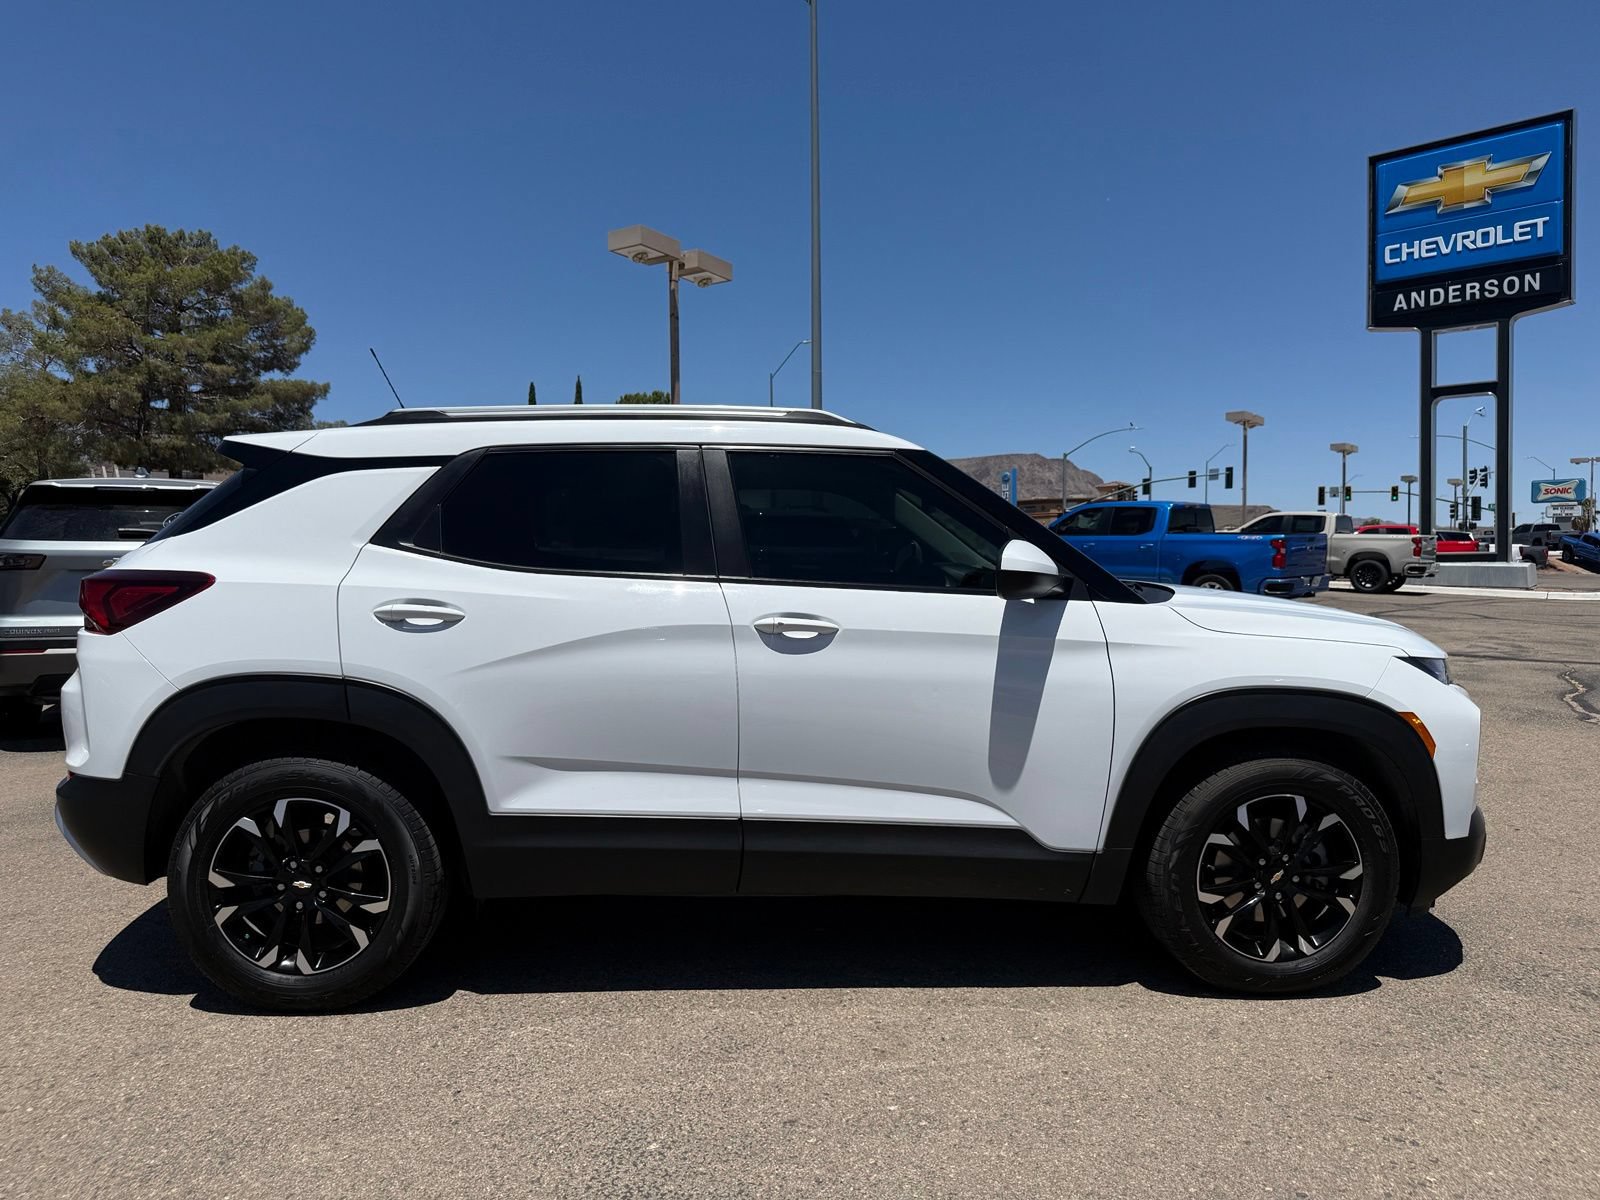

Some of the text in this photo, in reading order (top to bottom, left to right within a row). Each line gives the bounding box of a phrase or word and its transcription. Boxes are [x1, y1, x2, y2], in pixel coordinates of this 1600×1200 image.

[1384, 216, 1550, 265] CHEVROLET
[1393, 272, 1541, 312] ANDERSON
[1543, 487, 1572, 496] SONIC
